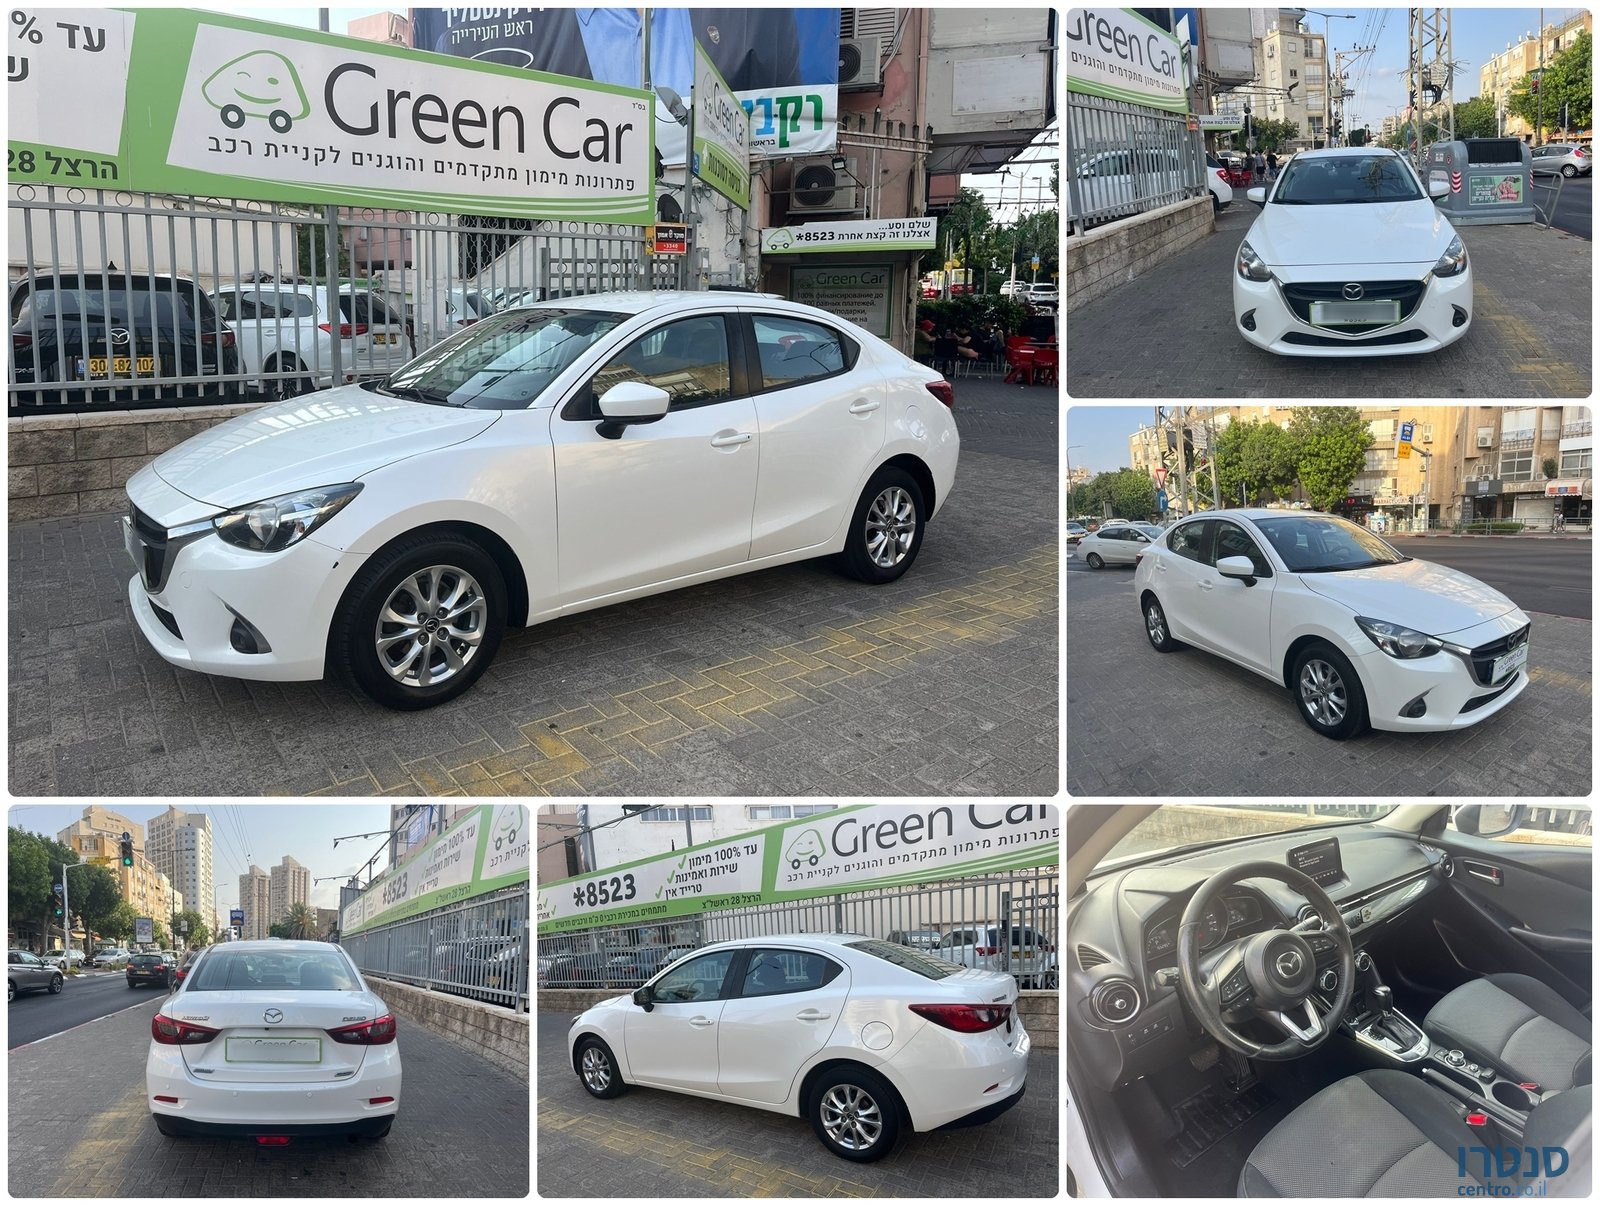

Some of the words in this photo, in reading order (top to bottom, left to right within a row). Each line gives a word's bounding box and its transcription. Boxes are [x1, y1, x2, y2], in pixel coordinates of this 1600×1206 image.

[452, 25, 499, 44] העירייה
[503, 20, 533, 37] ראש
[56, 22, 106, 52] עד
[1071, 51, 1106, 71] והוגנים
[1147, 34, 1176, 79] Car
[1109, 63, 1143, 82] מתקדמים
[324, 62, 525, 154] Green
[542, 96, 633, 164] Car
[713, 82, 734, 138] Green
[735, 110, 745, 146] Car
[208, 136, 252, 156] רכב
[264, 142, 341, 167] לקניית
[352, 151, 424, 172] והוגנים
[45, 151, 118, 180] הרצל
[434, 160, 518, 182] מתקדמים
[525, 169, 568, 186] מימון
[575, 173, 635, 191] פתרונות
[878, 222, 905, 231] וסע...
[908, 221, 931, 229] שלם
[837, 232, 863, 240] אחרת
[865, 231, 886, 241] קצת
[889, 230, 900, 239] זה
[902, 229, 930, 239] אצלנו
[816, 272, 858, 285] Green
[860, 271, 885, 284] Car
[815, 291, 873, 301] финансирование
[874, 292, 884, 300] до
[466, 824, 475, 839] עד
[831, 806, 953, 857] Green
[998, 828, 1059, 846] פתרונות
[448, 831, 464, 850] 100%
[953, 839, 991, 856] מימון
[714, 846, 741, 862] 100%
[743, 844, 758, 856] עד
[888, 847, 947, 865] מתקדמים
[490, 854, 503, 867] רכב
[688, 854, 712, 870] מימון
[844, 858, 883, 873] והוגנים
[675, 869, 708, 884] ואמינות
[709, 863, 738, 877] שירות
[787, 873, 803, 882] רכב
[807, 865, 840, 879] לקניית
[665, 888, 678, 901] אין
[679, 884, 702, 896] טרייד
[730, 896, 740, 905] 28
[741, 894, 761, 904] הרצל
[617, 909, 640, 919] במכירת
[641, 905, 667, 916] מתמחים
